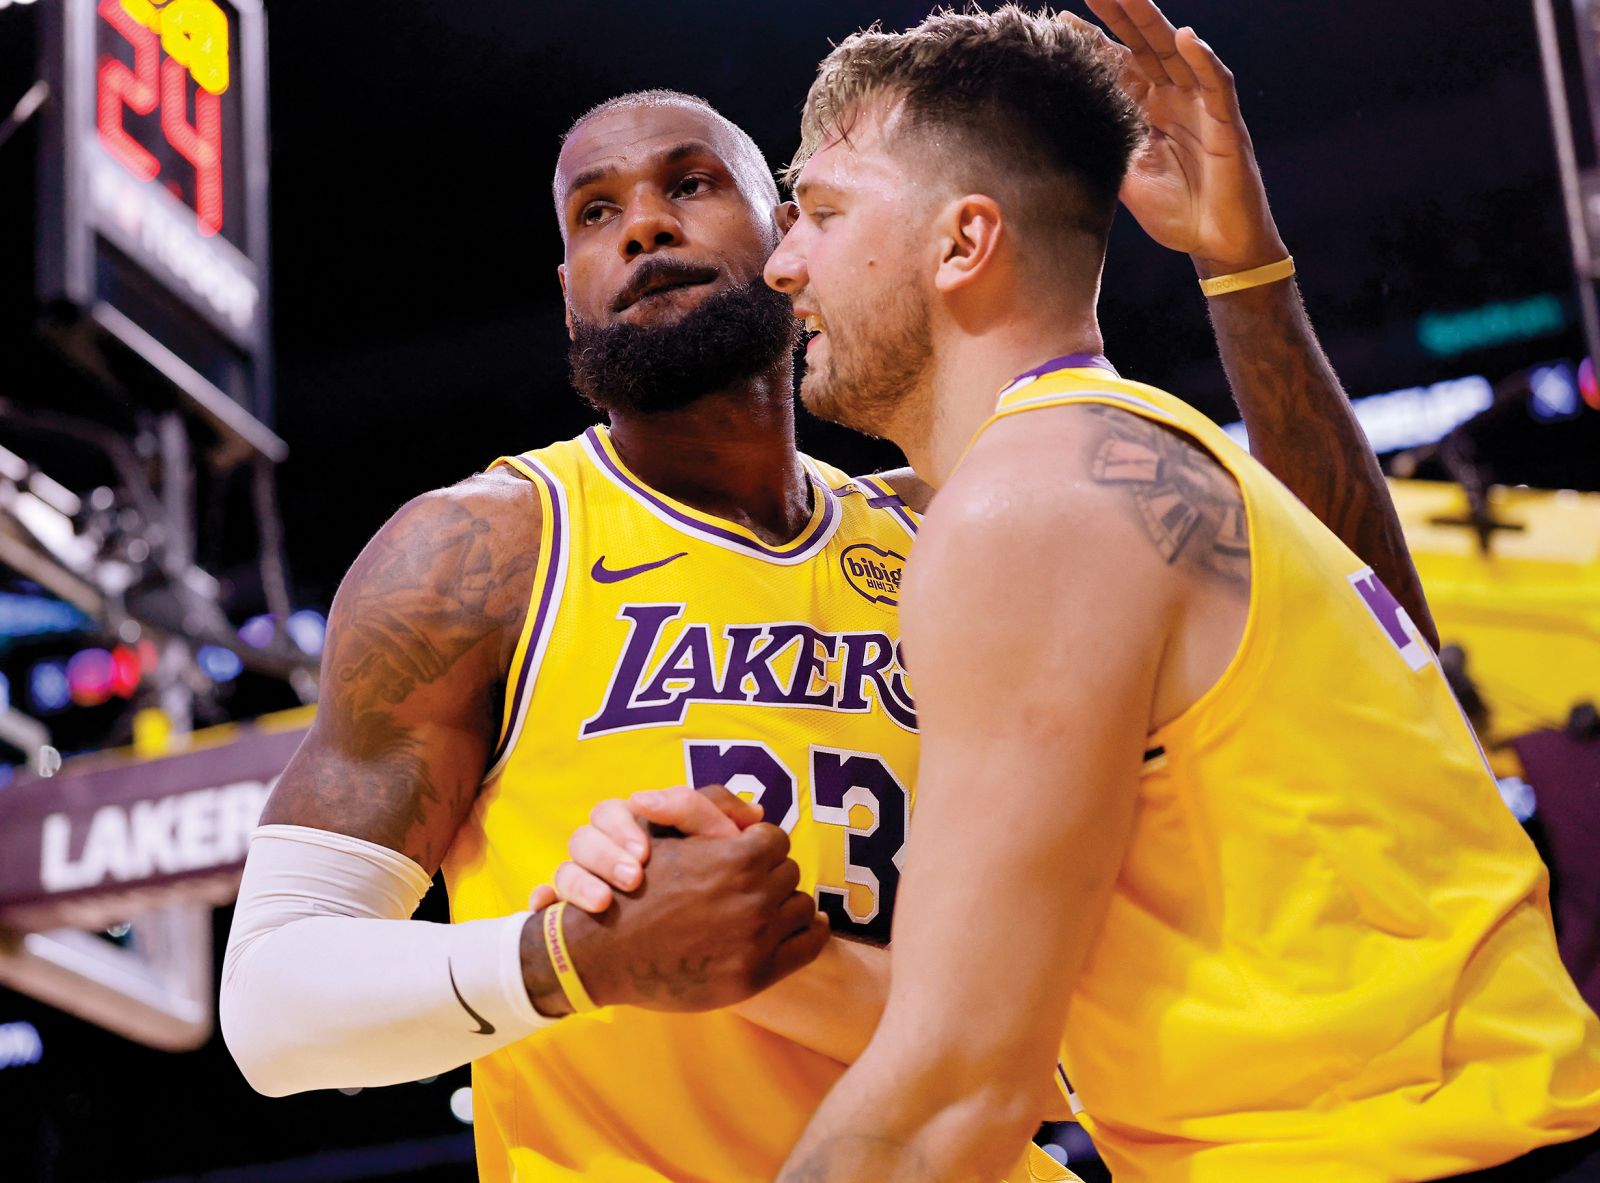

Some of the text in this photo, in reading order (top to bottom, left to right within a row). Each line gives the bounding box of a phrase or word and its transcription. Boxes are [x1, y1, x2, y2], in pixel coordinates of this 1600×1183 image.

[96, 0, 223, 237] 24
[847, 557, 902, 589] bibig
[41, 774, 281, 893] LAKER
